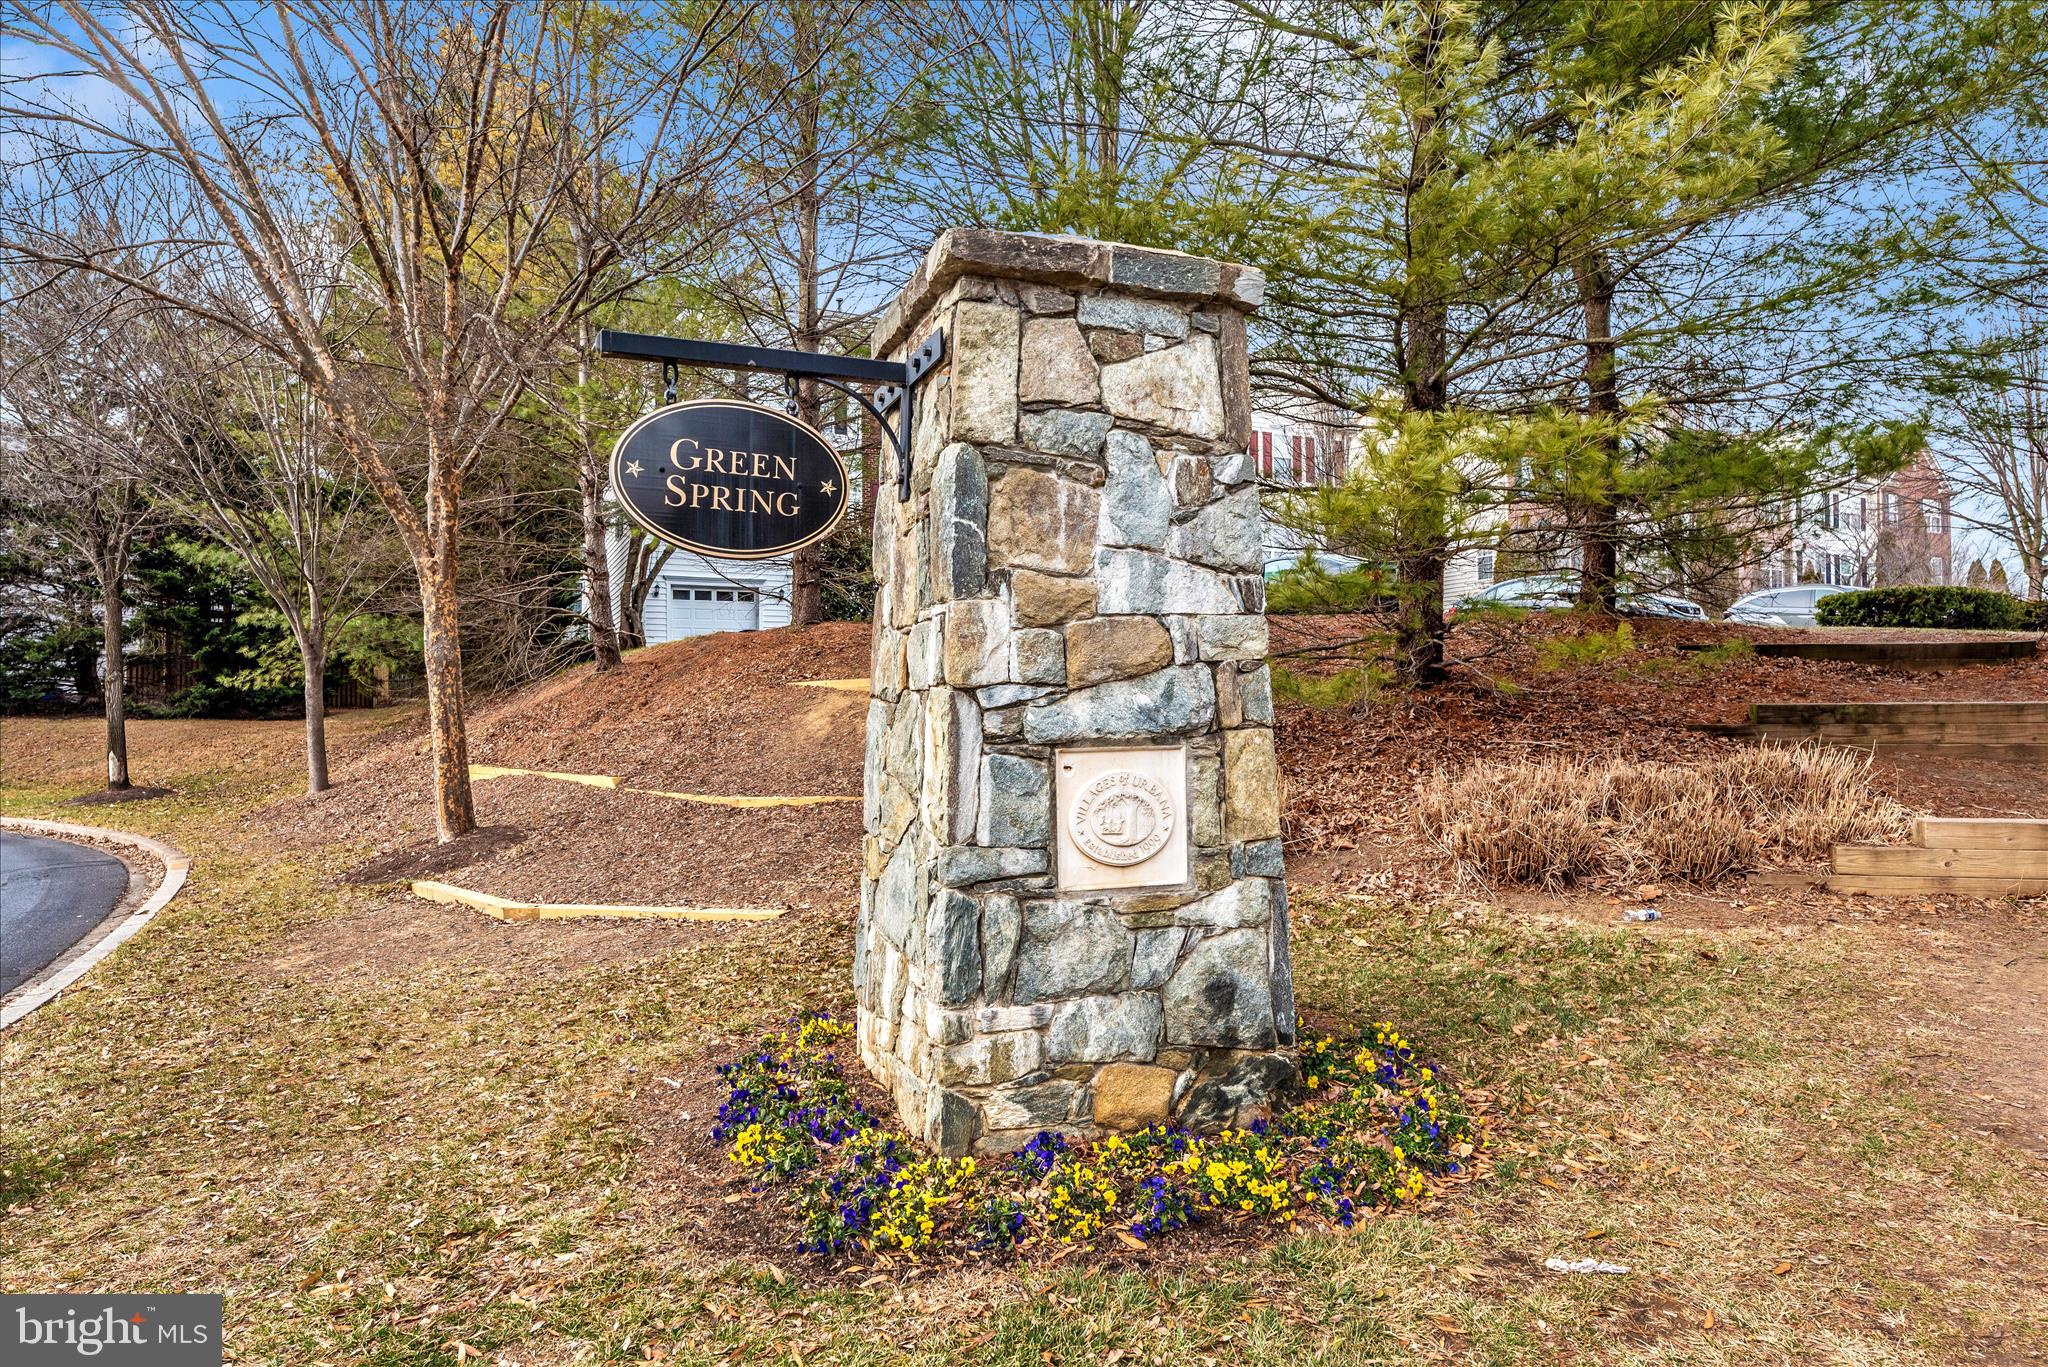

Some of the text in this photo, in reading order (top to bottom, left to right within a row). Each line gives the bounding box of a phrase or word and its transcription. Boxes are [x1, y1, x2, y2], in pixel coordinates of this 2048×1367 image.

[670, 438, 798, 480] GREEN
[665, 474, 801, 516] SPRING
[1076, 777, 1116, 826] VILLAGES
[1132, 776, 1172, 820] URBANA
